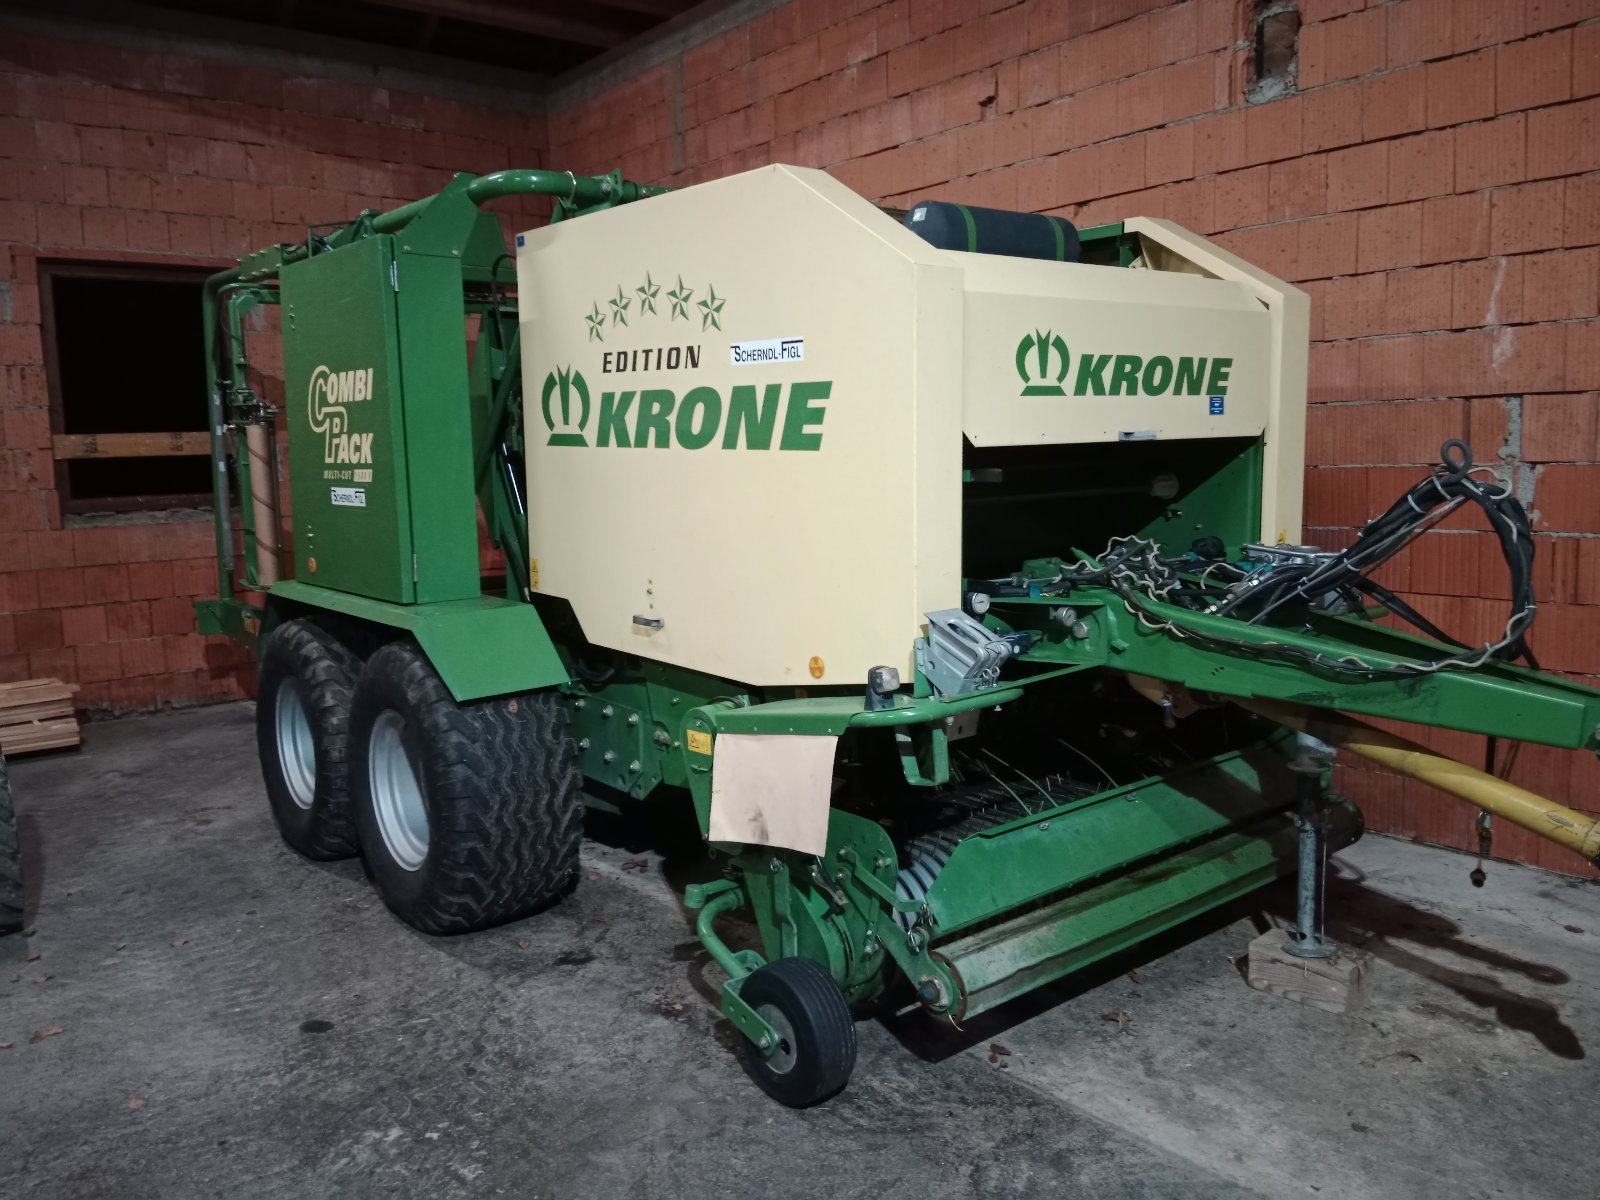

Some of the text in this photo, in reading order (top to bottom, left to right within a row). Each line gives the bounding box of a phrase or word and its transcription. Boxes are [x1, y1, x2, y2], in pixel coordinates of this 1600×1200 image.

[602, 345, 701, 374] EDITION
[1073, 353, 1233, 397] KRONE
[308, 364, 374, 433] COMBI
[596, 380, 833, 451] KRONE
[324, 406, 374, 464] PACK
